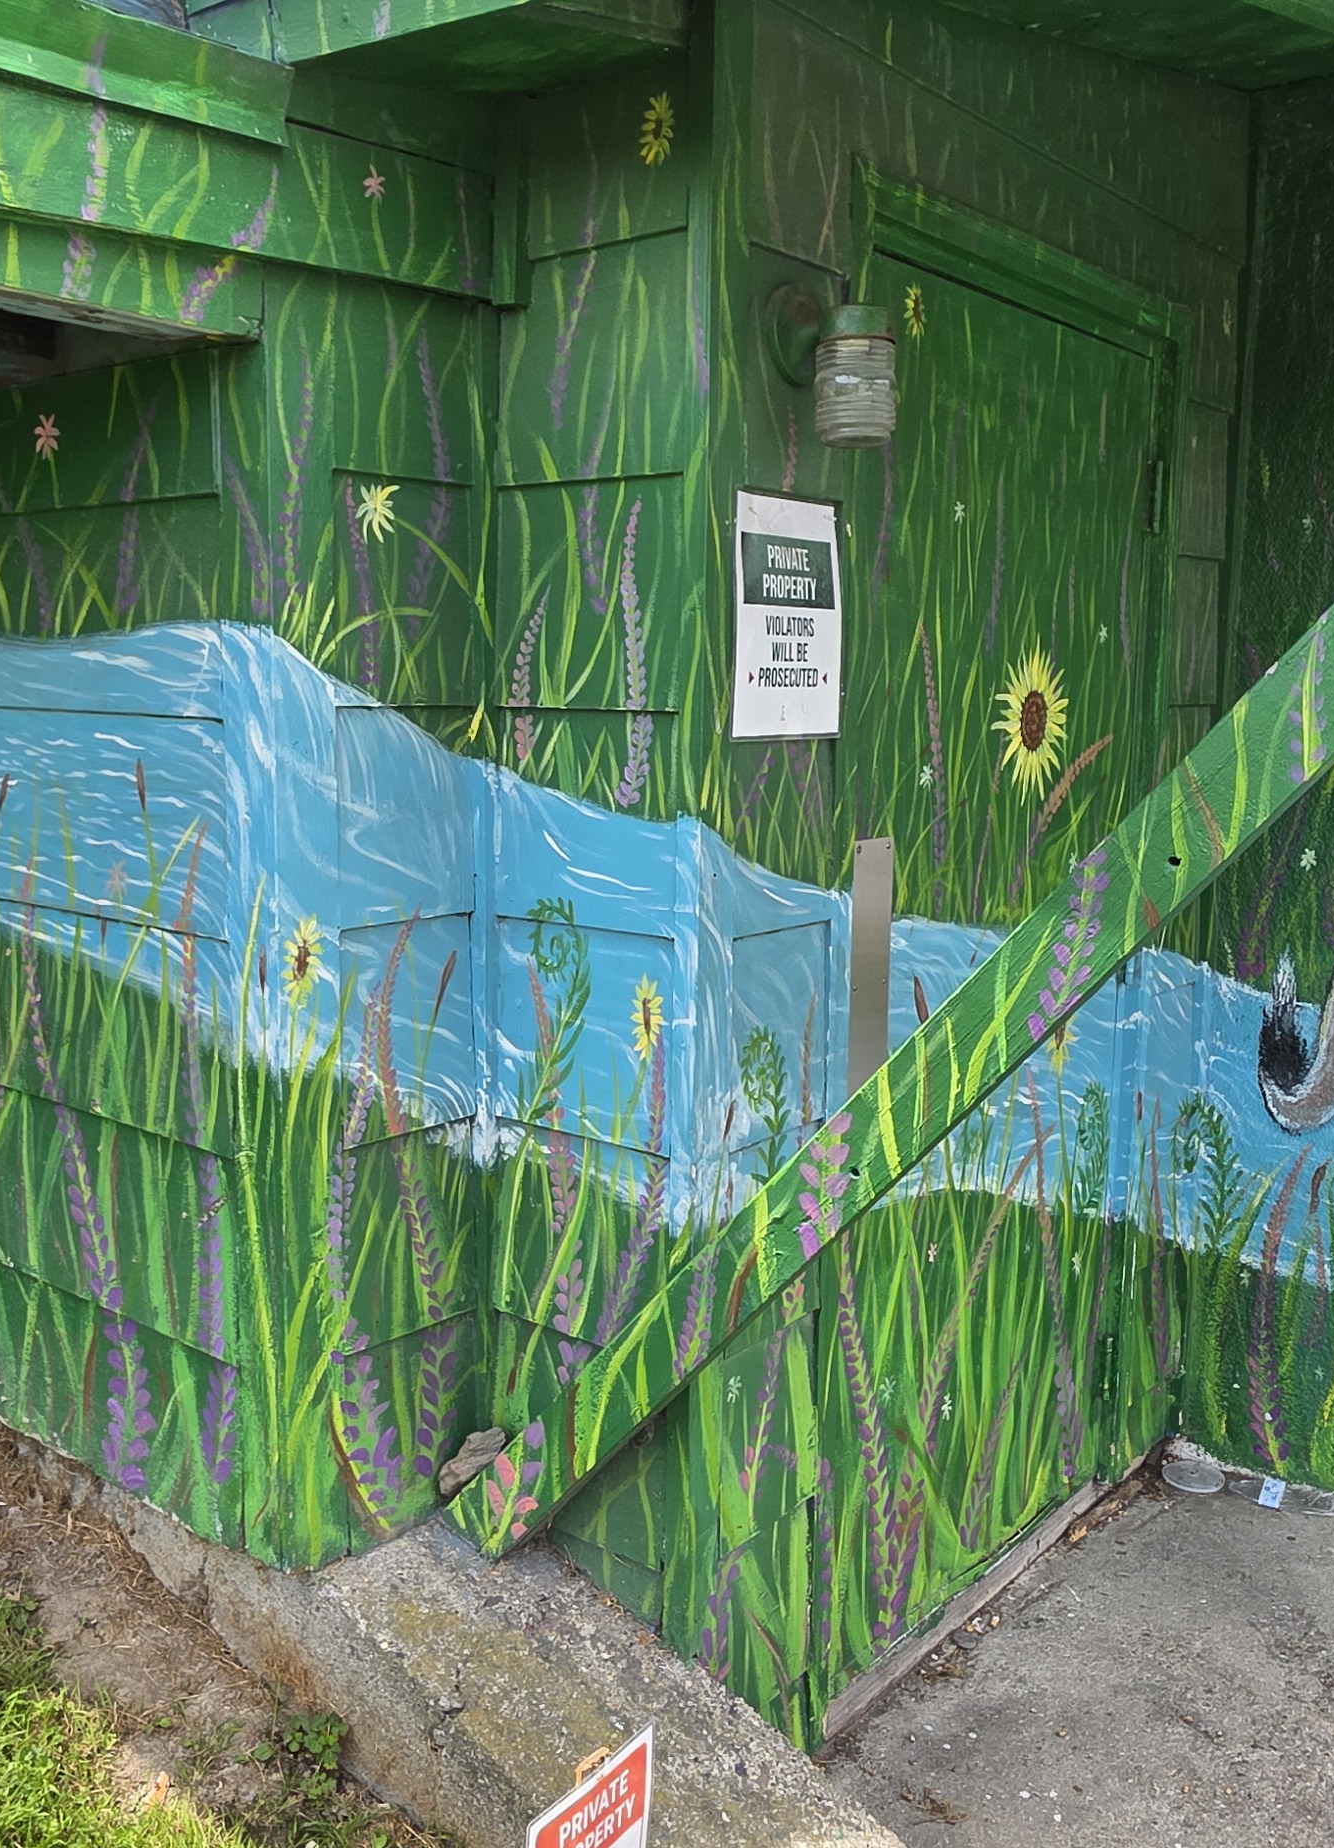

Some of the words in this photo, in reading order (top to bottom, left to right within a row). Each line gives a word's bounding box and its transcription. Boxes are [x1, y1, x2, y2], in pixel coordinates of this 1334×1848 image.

[767, 544, 810, 572] PRIVATE
[762, 574, 817, 601] PROPERTY
[765, 615, 815, 637] VIOLATORS
[771, 642, 795, 663] WILL
[797, 642, 809, 663] BE
[758, 667, 819, 688] PROSECUTED
[559, 1768, 629, 1848] PRIVATE
[575, 1793, 636, 1848] PERTY
